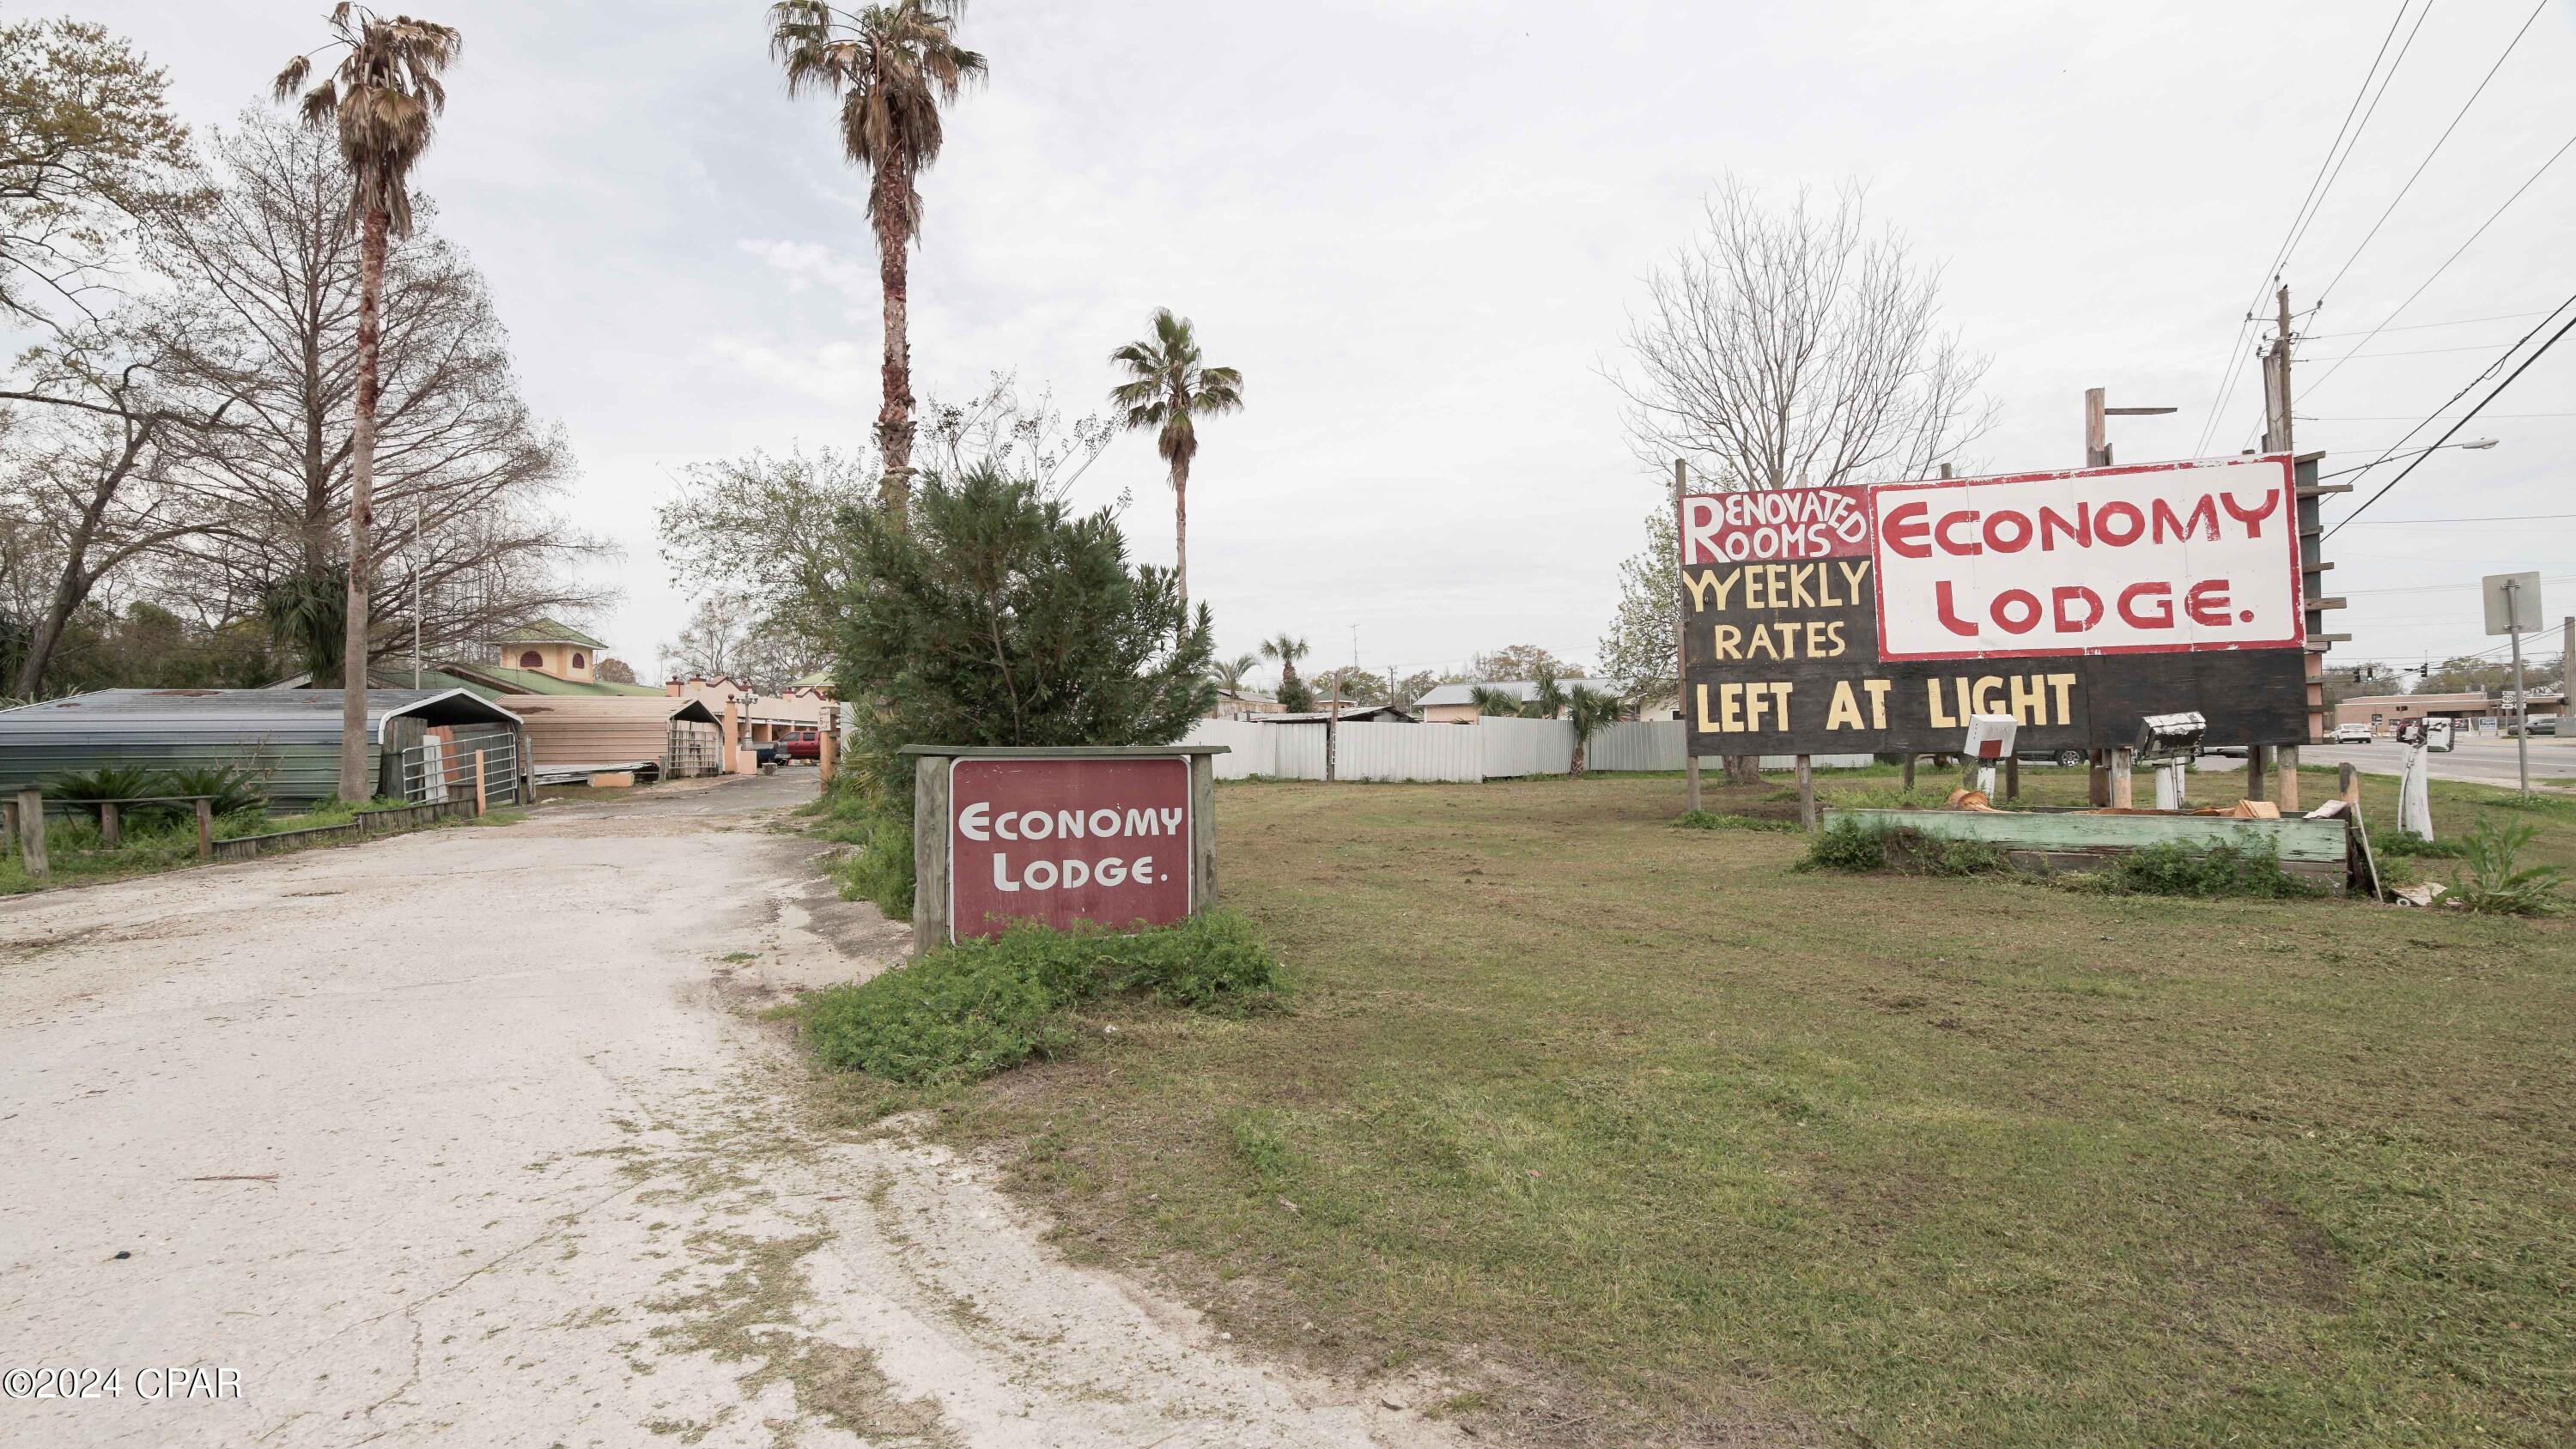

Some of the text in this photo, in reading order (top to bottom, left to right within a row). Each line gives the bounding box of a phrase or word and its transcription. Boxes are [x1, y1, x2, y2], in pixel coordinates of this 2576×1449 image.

[1683, 490, 1867, 565] RENOVATED
[1881, 488, 2280, 559] ECONOMY
[1682, 561, 1871, 613] WEEKLY
[1935, 579, 2255, 637] LODGE.
[1715, 621, 1846, 659] RATES
[1697, 673, 2076, 732] LEFT AT LIGHT
[958, 802, 1182, 841] ECONOMY
[993, 852, 1168, 892] LODGE.
